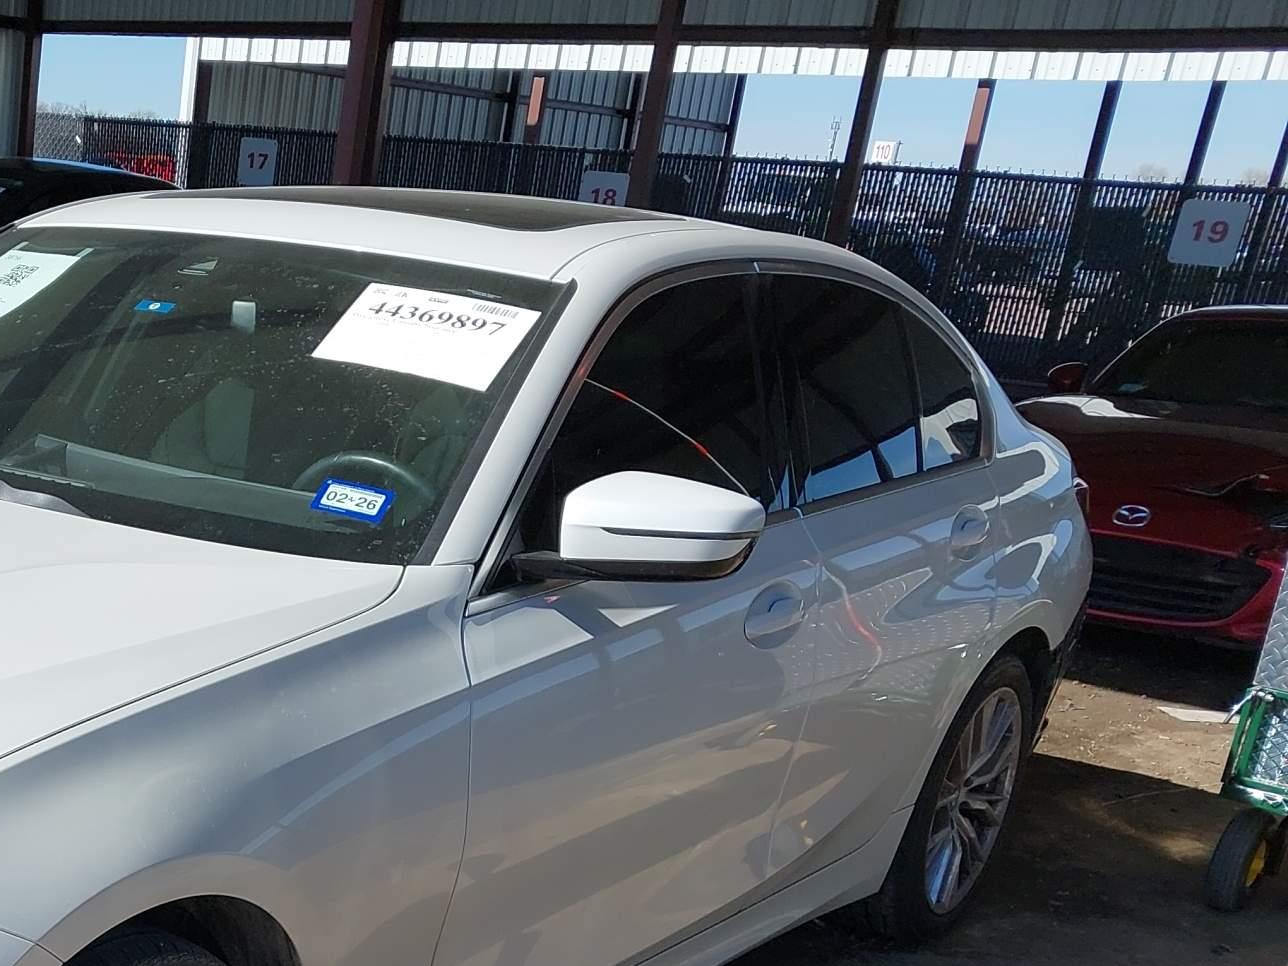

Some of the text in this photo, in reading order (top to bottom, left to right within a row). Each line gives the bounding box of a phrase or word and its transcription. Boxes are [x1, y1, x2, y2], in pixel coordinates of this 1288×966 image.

[247, 151, 269, 170] 17
[875, 144, 891, 160] 110
[591, 187, 617, 206] 18
[1192, 219, 1230, 243] 19
[368, 301, 507, 336] 44369897
